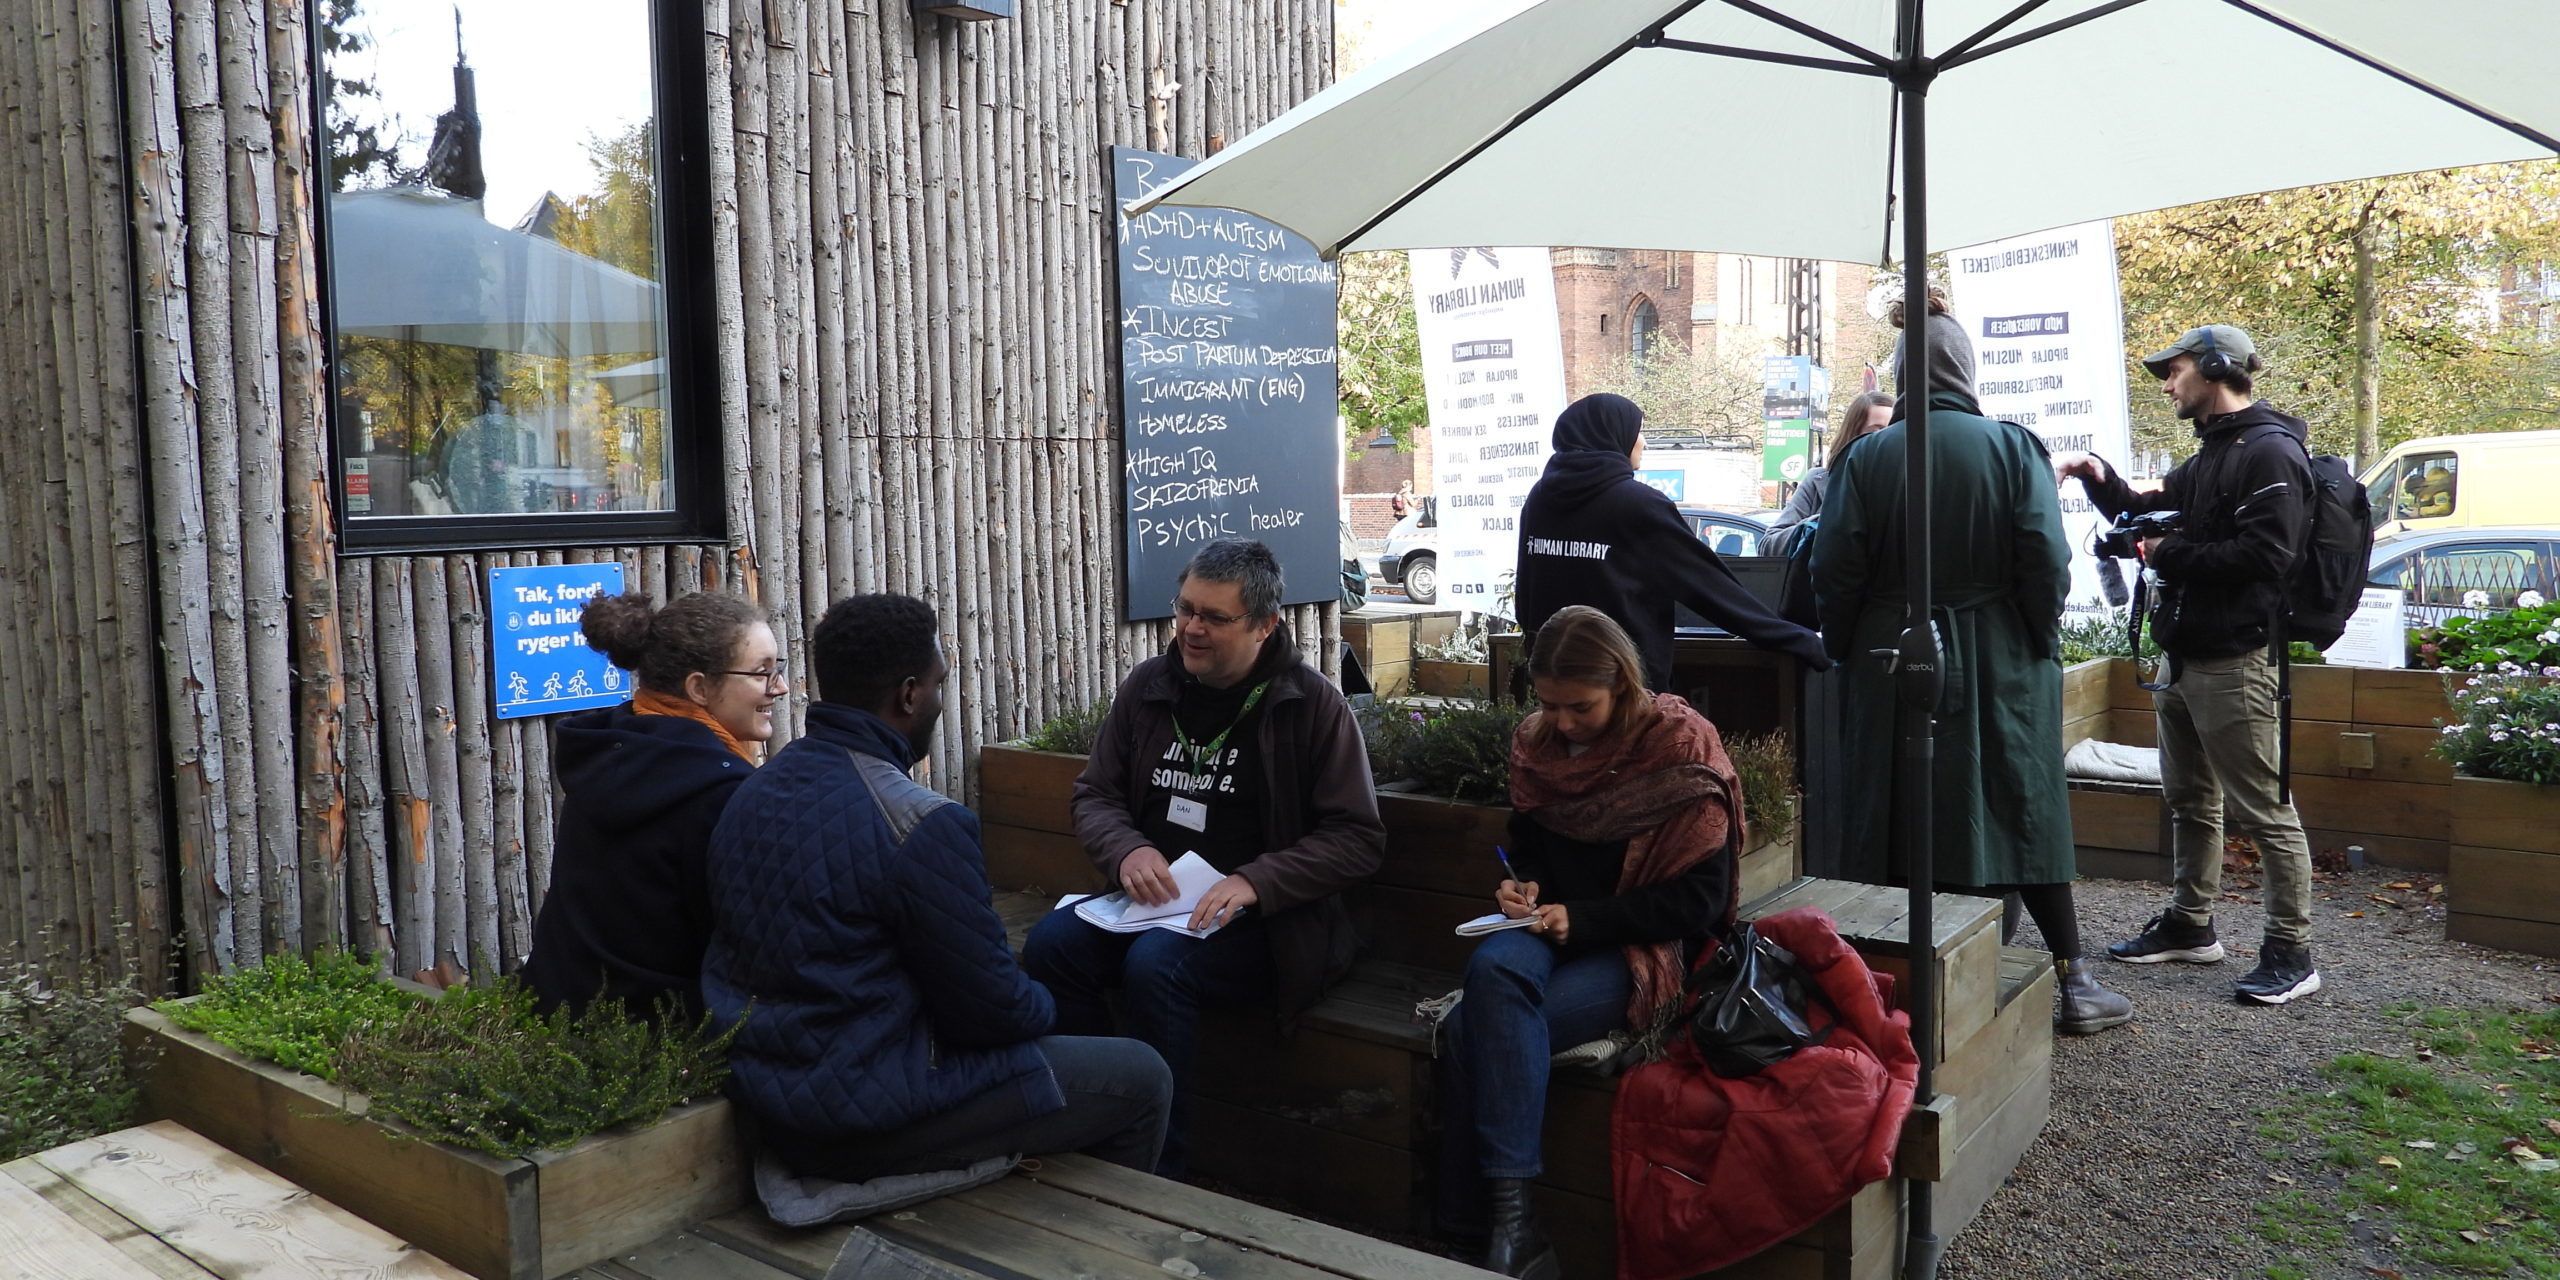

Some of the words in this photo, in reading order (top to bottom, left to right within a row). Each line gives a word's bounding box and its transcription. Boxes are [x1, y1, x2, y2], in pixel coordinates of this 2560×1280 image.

[1259, 260, 1337, 284] EMOTIONAL
[1170, 282, 1232, 307] ABUSE
[1137, 305, 1234, 337] INCEST
[1137, 339, 1188, 368] POST
[1190, 340, 1258, 371] PARTUM
[1136, 377, 1255, 403] IMMIGRANT
[1259, 371, 1305, 406] (ENG)
[1138, 411, 1228, 437] HOMELESS
[1139, 447, 1185, 477] HIGH
[1187, 446, 1218, 475] IQ
[1785, 461, 1800, 472] SF
[1132, 473, 1260, 512] SKIZOFRENIA
[1249, 504, 1305, 531] healer
[1533, 538, 1563, 556] HUMAN
[1564, 541, 1609, 560] LIBRARY
[515, 586, 553, 604] Tak,
[527, 611, 552, 626] du
[517, 634, 570, 655] ryger
